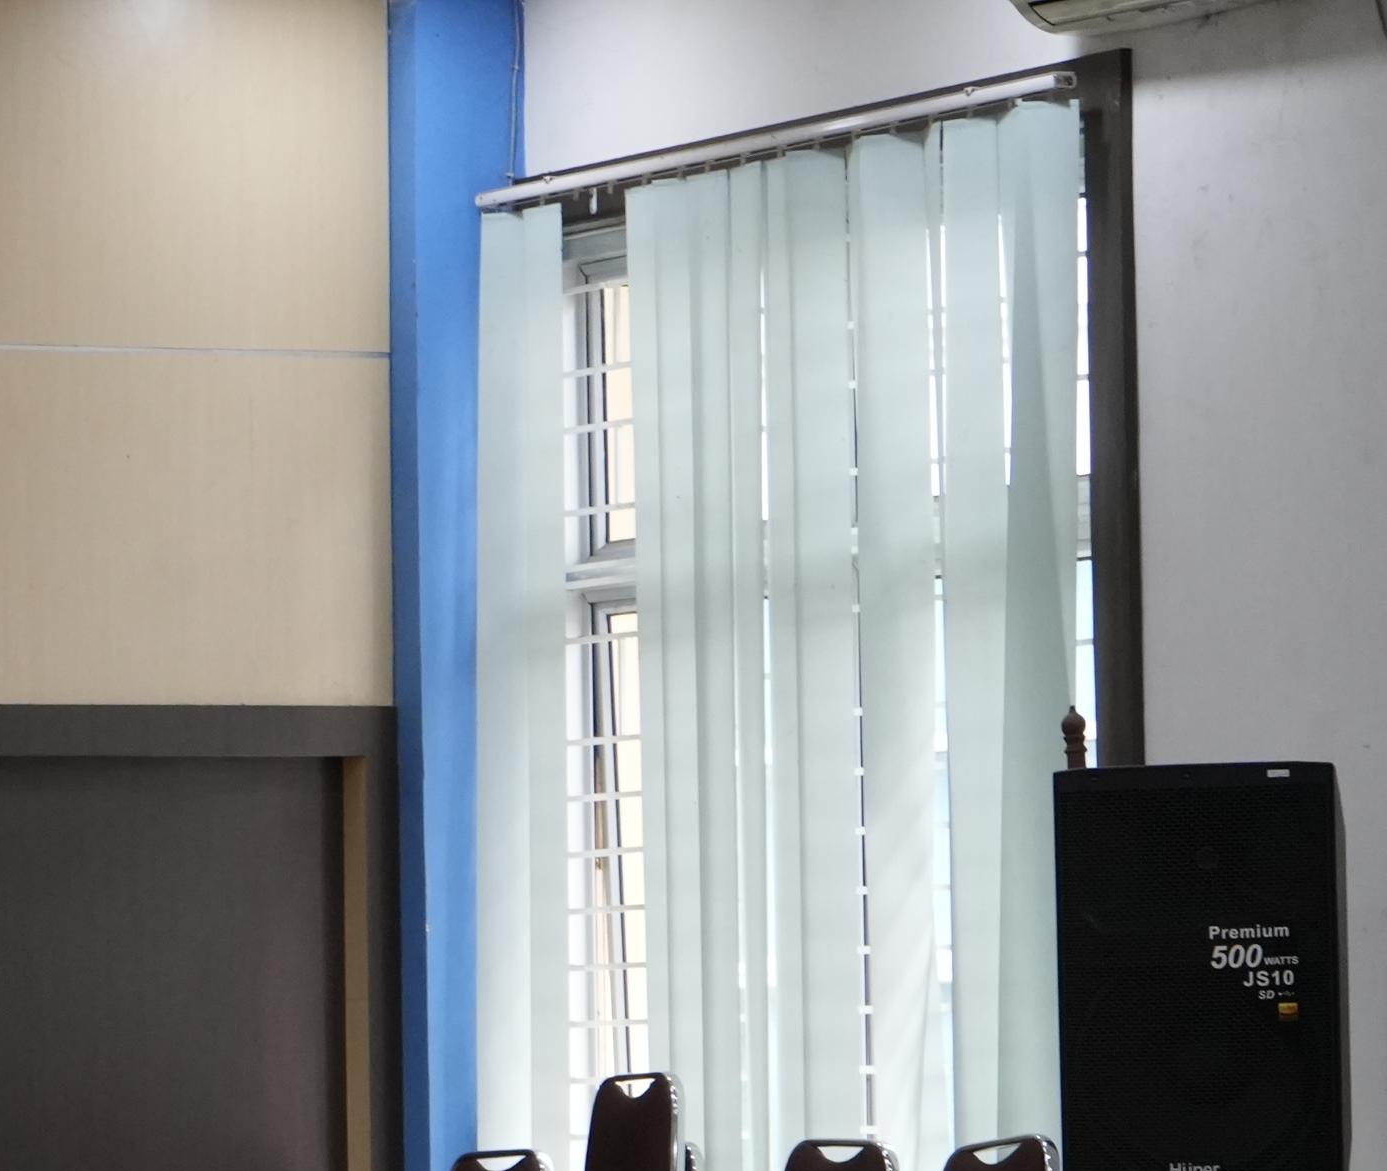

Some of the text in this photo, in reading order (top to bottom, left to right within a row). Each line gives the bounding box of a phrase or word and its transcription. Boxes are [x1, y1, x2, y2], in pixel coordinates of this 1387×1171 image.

[1208, 924, 1290, 940] Premium
[1210, 944, 1299, 970] 500 WATTS
[1243, 970, 1294, 987] JS10
[1258, 990, 1275, 1000] SD
